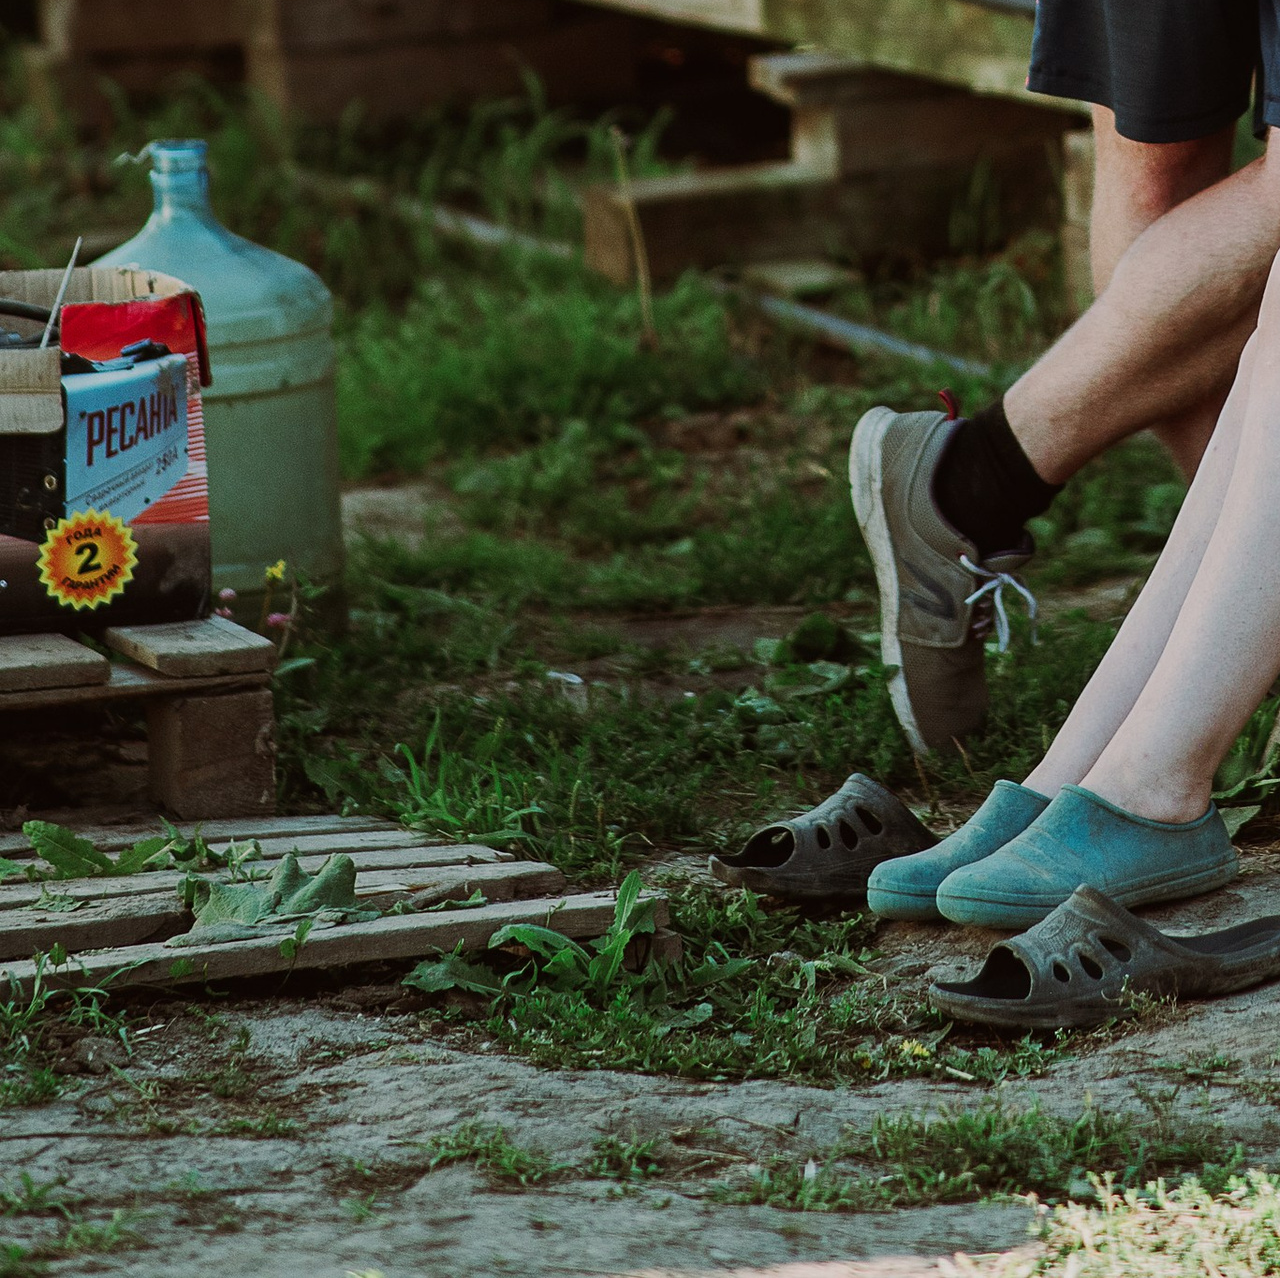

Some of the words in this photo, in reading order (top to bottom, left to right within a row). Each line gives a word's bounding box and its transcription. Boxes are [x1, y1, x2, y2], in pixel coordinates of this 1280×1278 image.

[65, 527, 102, 545] ГОДА
[75, 542, 102, 575] 2
[61, 564, 121, 590] ГАРАНТИИ
